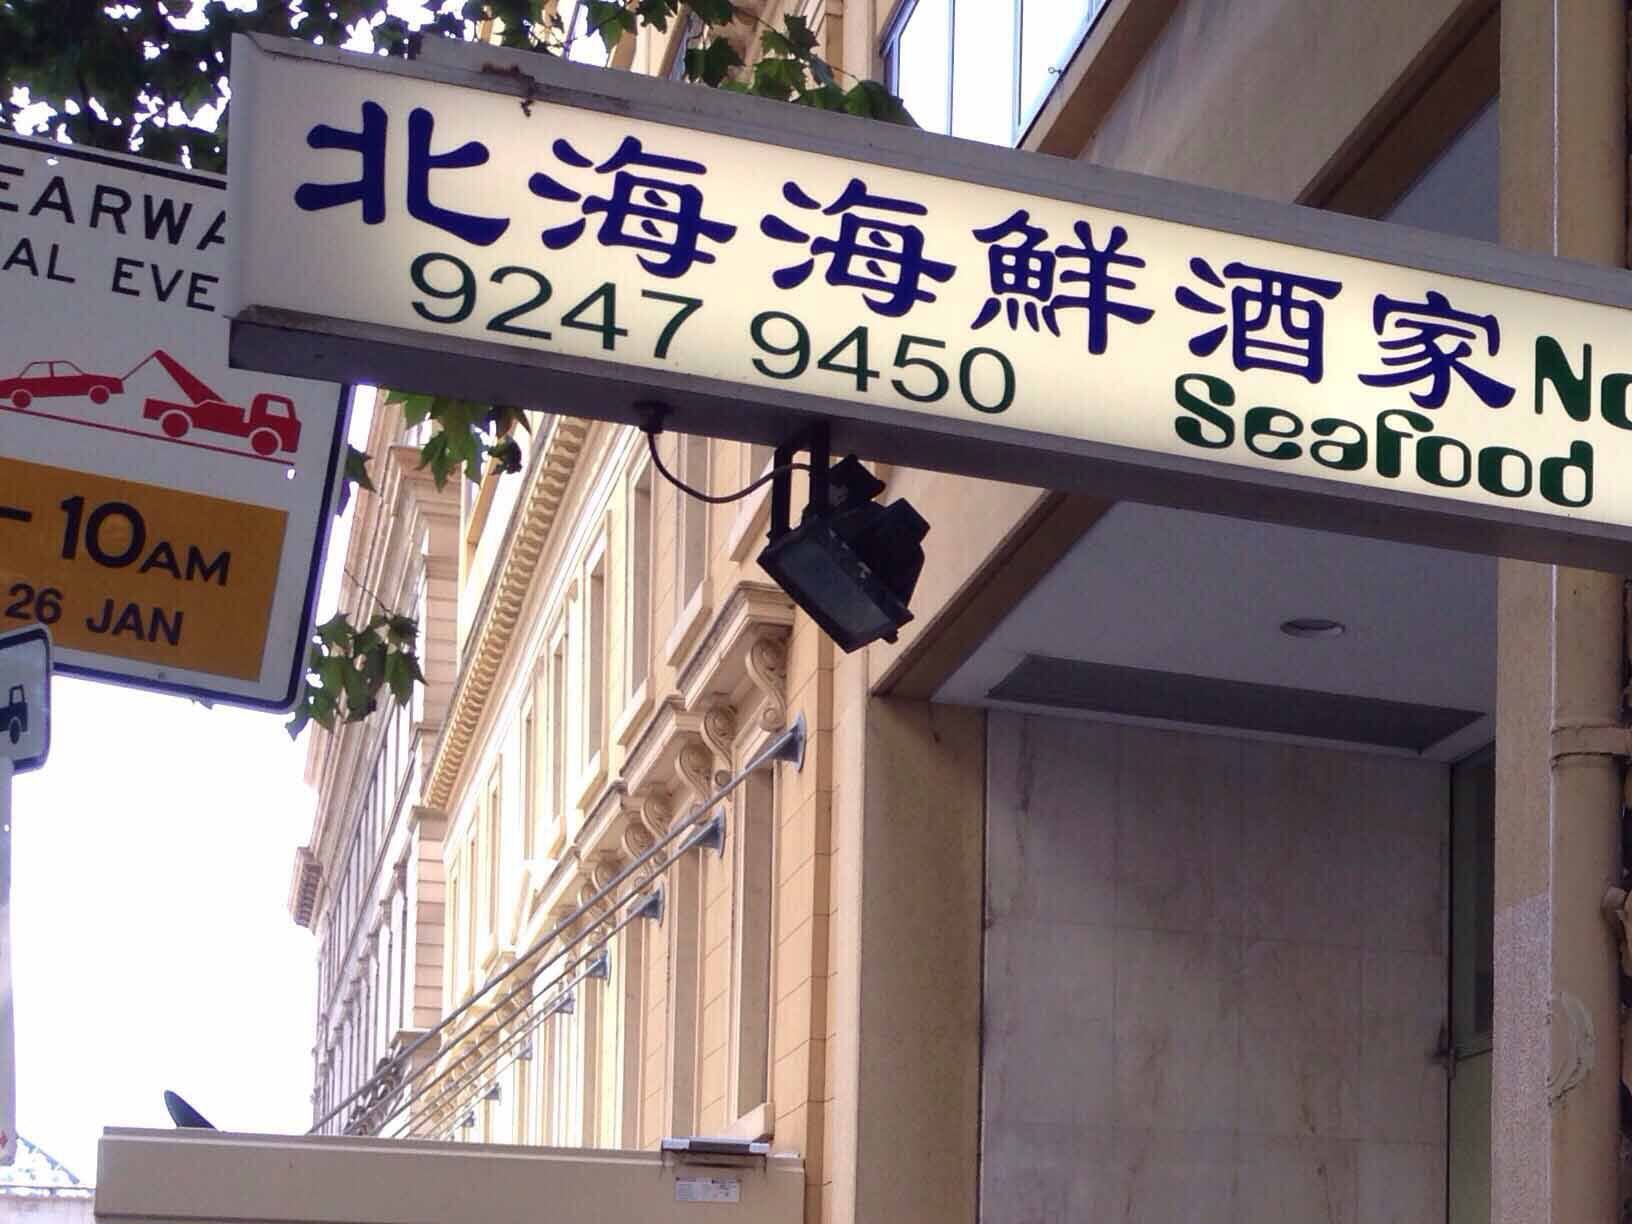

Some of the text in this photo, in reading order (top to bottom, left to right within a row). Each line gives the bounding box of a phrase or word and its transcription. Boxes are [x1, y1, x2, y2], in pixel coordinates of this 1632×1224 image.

[2, 237, 220, 312] AL EVE
[294, 100, 1516, 410] 北海海鮮酒家
[408, 251, 1017, 415] 9247 9450
[1173, 372, 1594, 509] Seafood
[5, 583, 185, 646] 26 JAN
